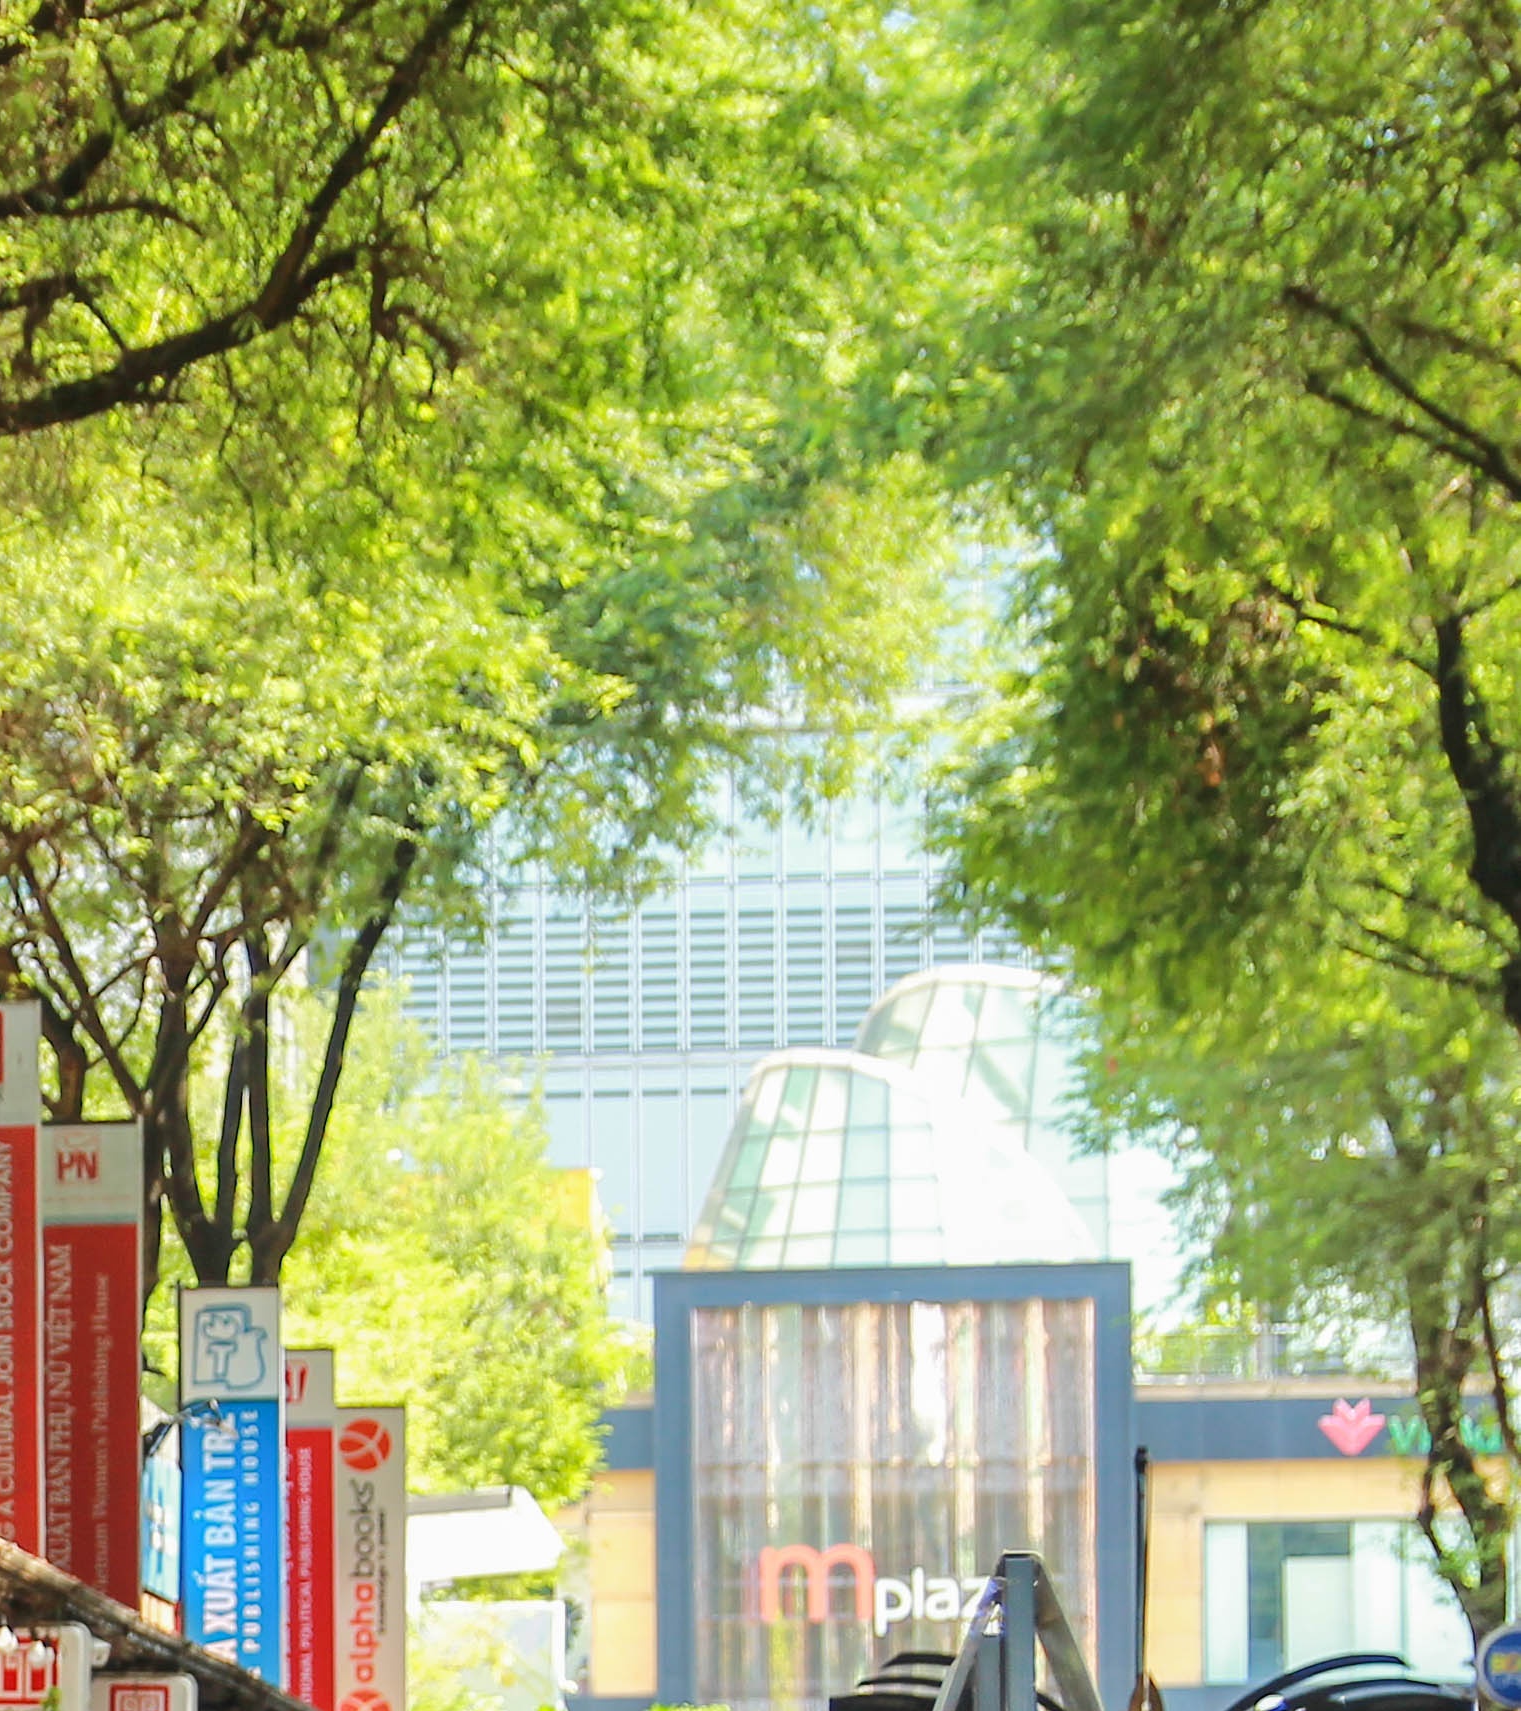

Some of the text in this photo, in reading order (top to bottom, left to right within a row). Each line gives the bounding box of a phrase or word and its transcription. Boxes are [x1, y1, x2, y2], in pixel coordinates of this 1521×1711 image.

[47, 1244, 73, 1300] NAM
[239, 1408, 260, 1485] HOUSE
[192, 1478, 237, 1546] BẢN
[192, 1553, 238, 1635] XUẤT
[241, 1500, 262, 1653] PUBLISHING
